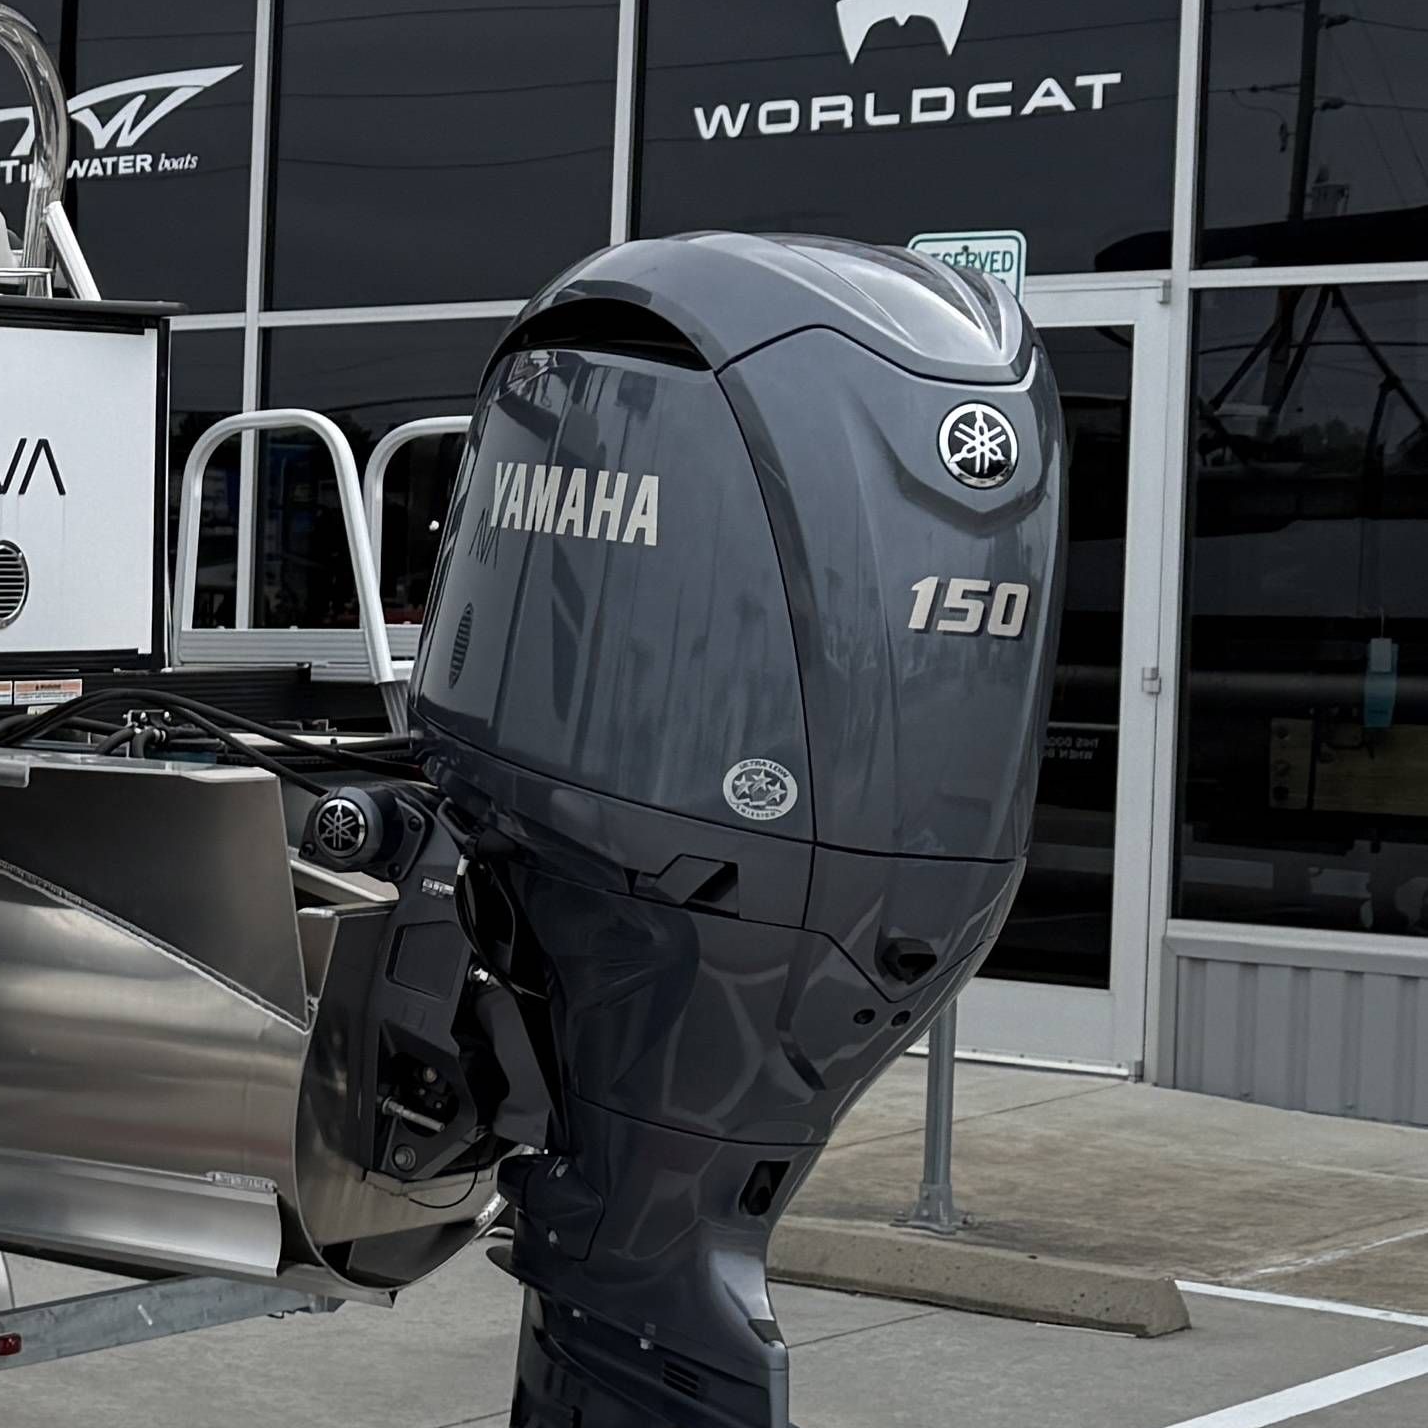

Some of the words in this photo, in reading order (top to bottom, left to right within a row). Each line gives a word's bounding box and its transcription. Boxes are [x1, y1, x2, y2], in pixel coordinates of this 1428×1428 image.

[694, 73, 1122, 140] WORLDCAT
[0, 154, 152, 184] TIWATER
[158, 152, 198, 172] boats
[490, 462, 659, 546] YAMAHA
[908, 576, 1029, 637] 150
